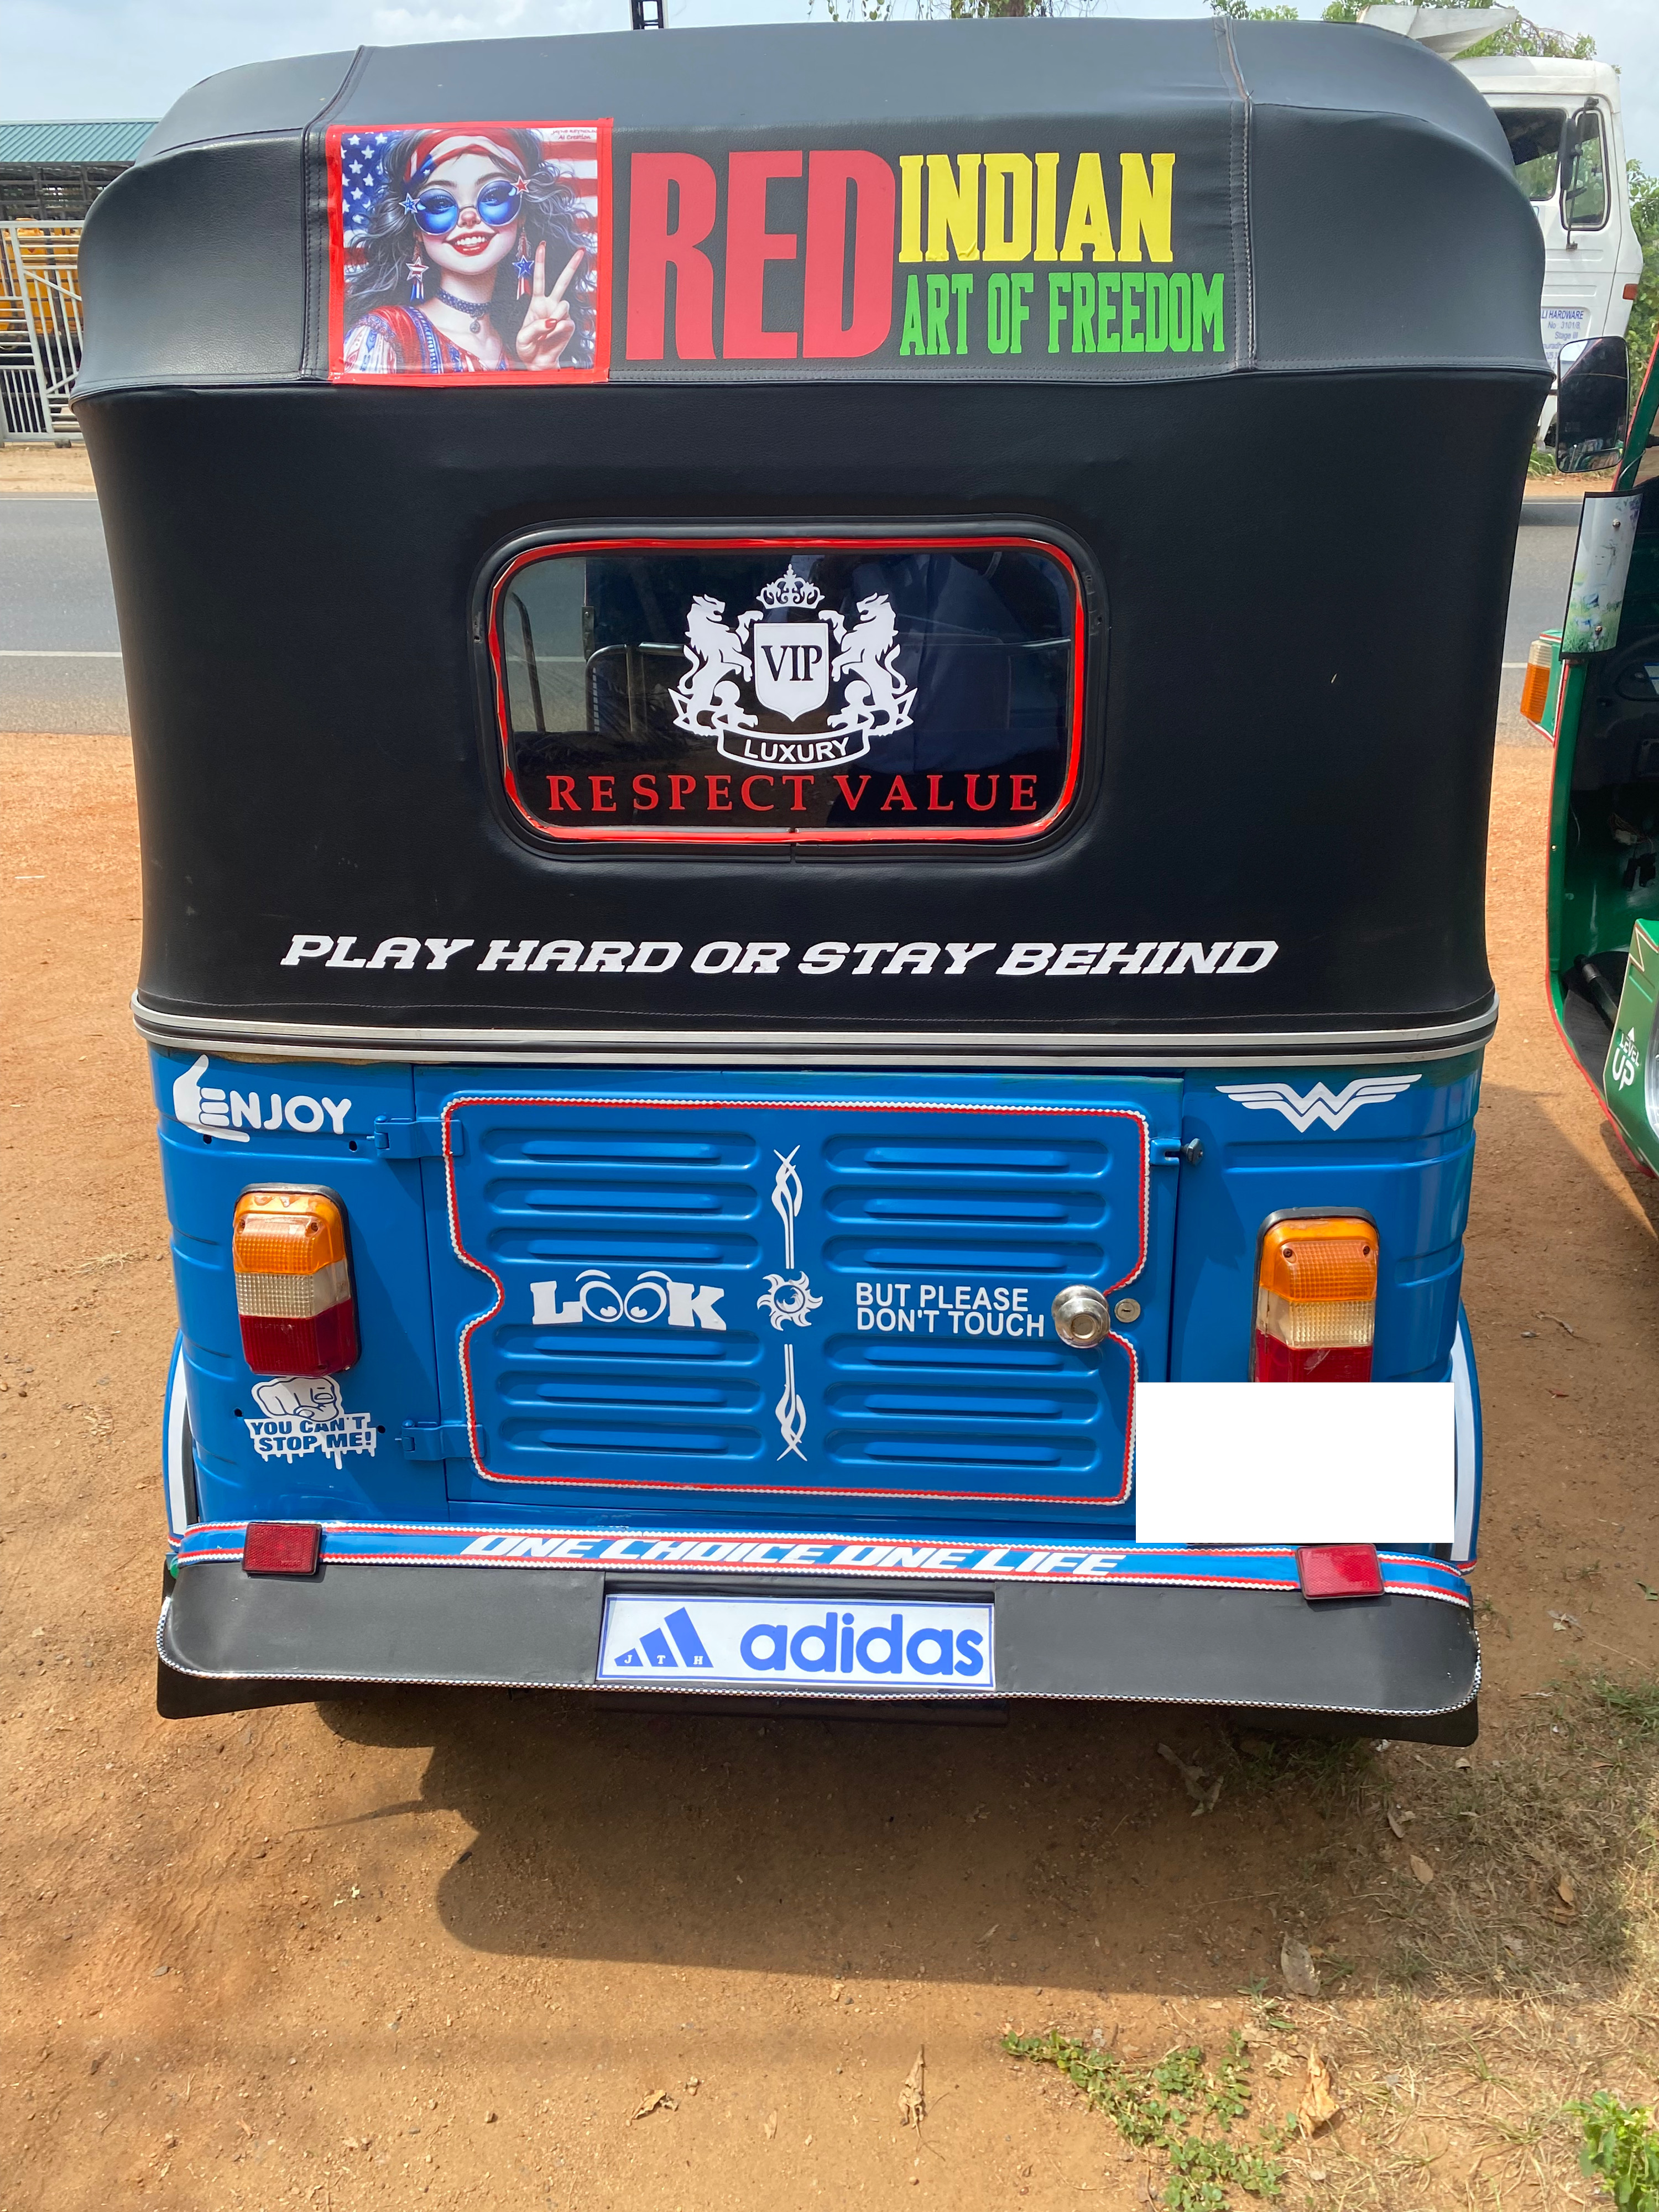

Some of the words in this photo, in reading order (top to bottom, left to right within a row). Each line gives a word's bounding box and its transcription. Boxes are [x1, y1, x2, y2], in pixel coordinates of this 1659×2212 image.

[899, 153, 1176, 262] INDIAN
[625, 150, 896, 361] RED
[900, 273, 973, 356] ART
[988, 273, 1034, 354] OF
[1048, 273, 1224, 353] FREEDOM
[1549, 310, 1584, 319] HARDWARE
[1555, 332, 1571, 341] Stage
[761, 644, 822, 682] VIP
[743, 736, 850, 763] LUXURY
[546, 775, 817, 811] RESPECT
[834, 775, 1037, 811] VALUE
[281, 935, 474, 969] PLAY
[477, 940, 683, 973] HARD
[691, 941, 791, 973] OR
[797, 942, 997, 975] STAY
[996, 941, 1279, 975] BEHIND
[1613, 1047, 1635, 1091] UP
[173, 1070, 352, 1140] ENJOY
[530, 1272, 727, 1331] LOOK
[857, 1282, 911, 1307] BUT
[920, 1285, 1029, 1311] PLEASE
[857, 1307, 940, 1333] DON'T
[948, 1311, 1044, 1337] TOUCH
[251, 1421, 292, 1434] YOU
[300, 1416, 365, 1432] CAN'T
[259, 1436, 317, 1452] STOP
[326, 1431, 371, 1448] ME!
[460, 1535, 602, 1558] ONE
[599, 1538, 828, 1564] CHOICE
[830, 1544, 975, 1569] ONE
[971, 1547, 1126, 1575] LIFE
[624, 1655, 633, 1664] J
[656, 1655, 666, 1665] T
[693, 1656, 703, 1665] H
[740, 1611, 984, 1677] adidas
